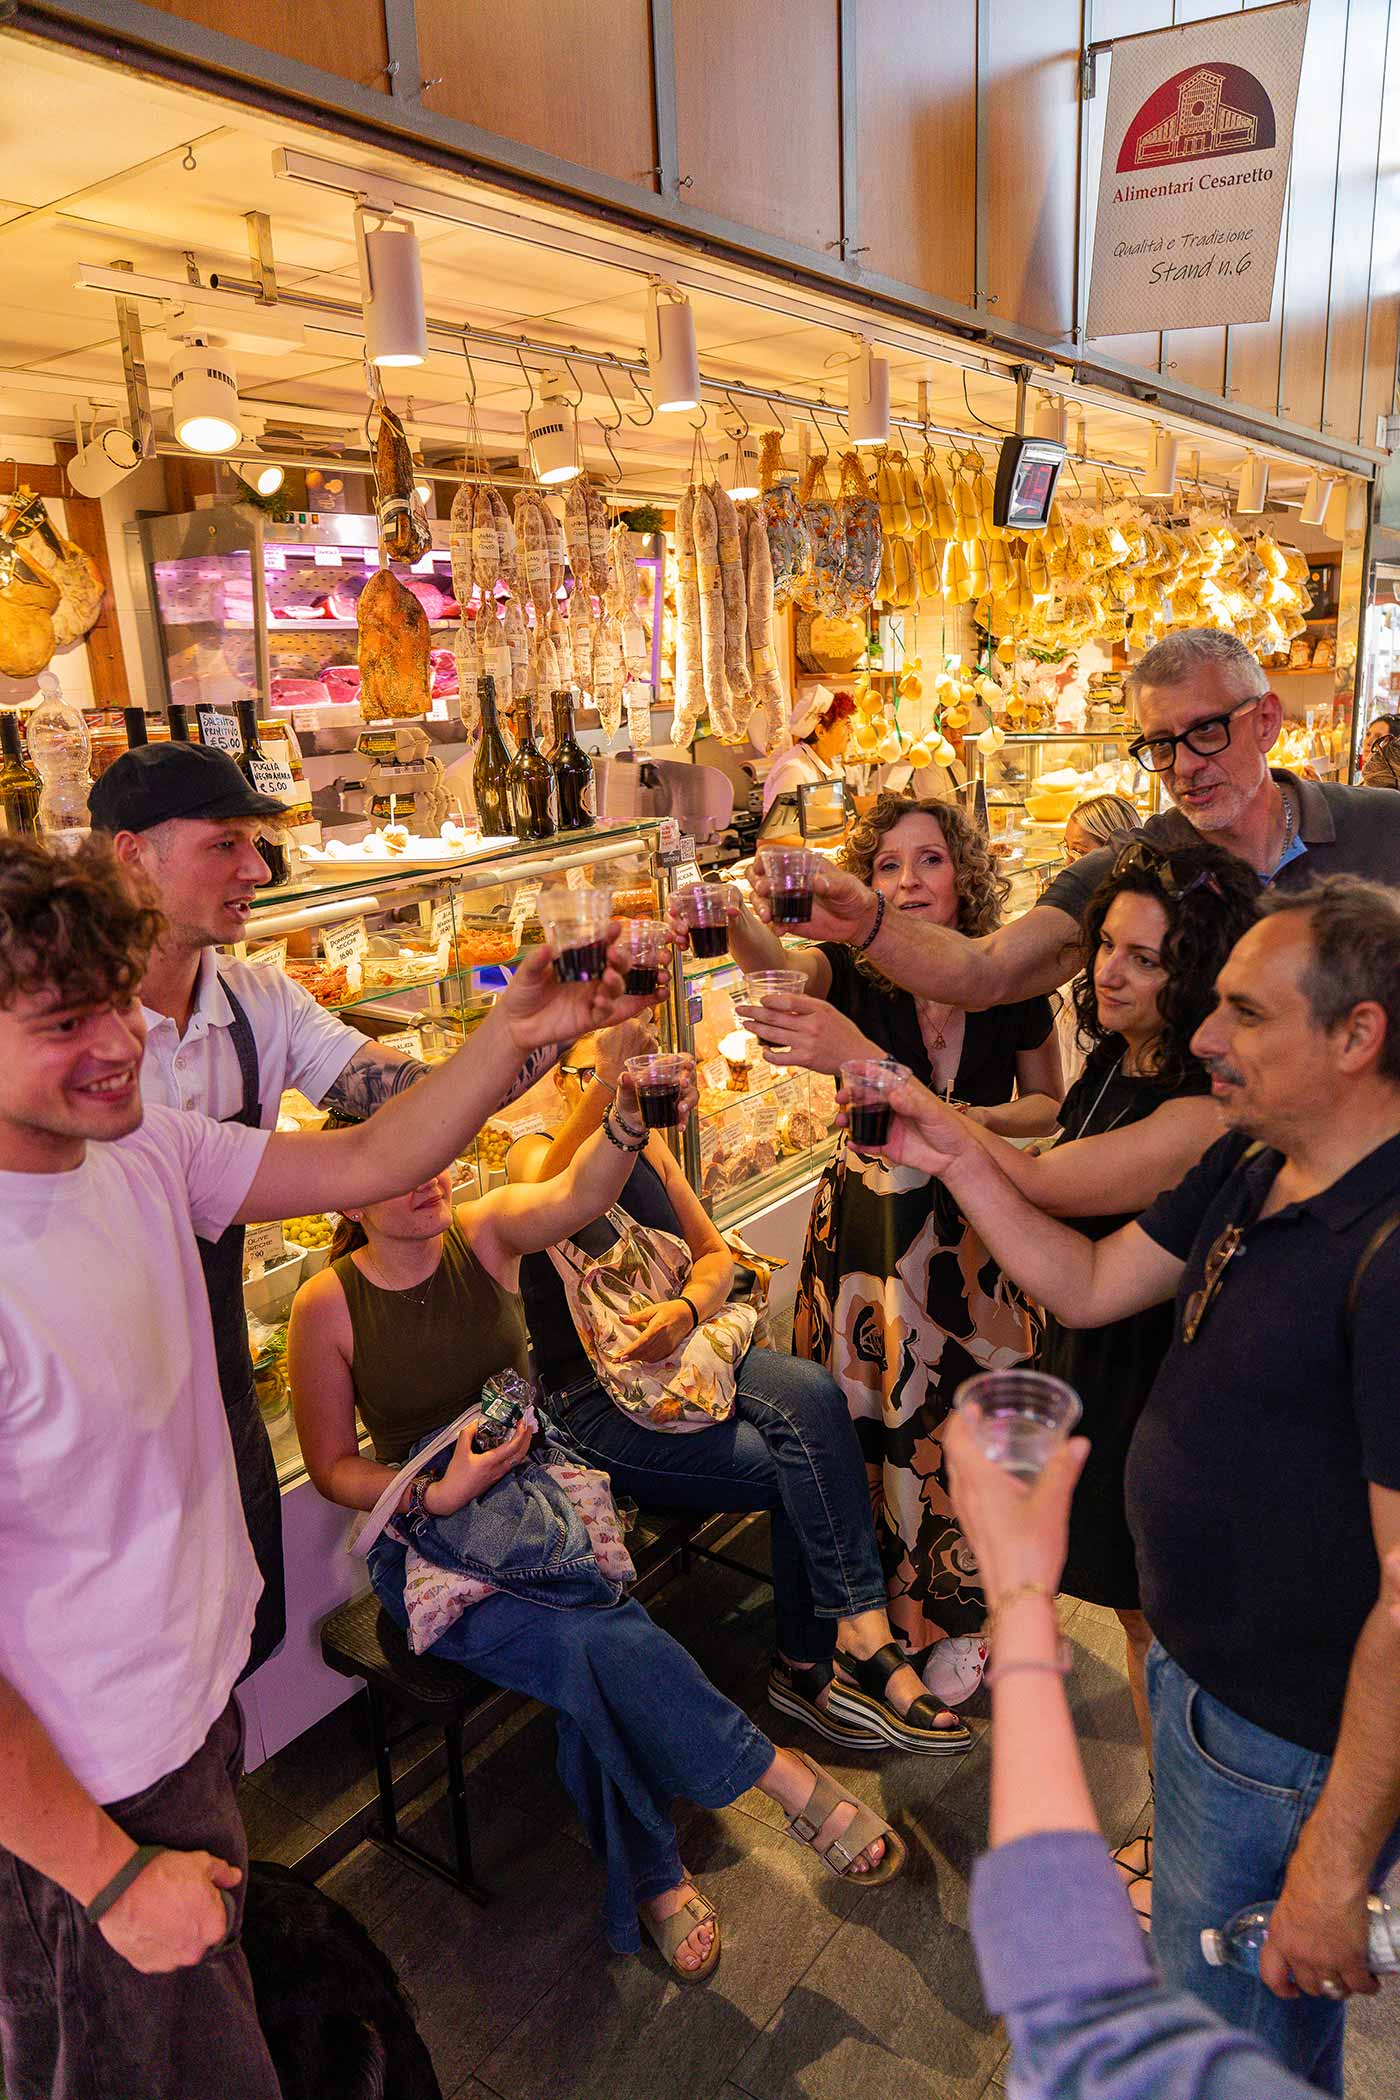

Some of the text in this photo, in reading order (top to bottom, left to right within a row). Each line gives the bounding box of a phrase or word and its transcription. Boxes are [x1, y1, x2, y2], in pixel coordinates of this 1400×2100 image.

[1112, 167, 1273, 204] Alimentari Cesaretto
[1113, 228, 1254, 258] Qualità e Tradizione
[1148, 252, 1252, 285] Stand n.6
[204, 727, 239, 737] PRIMITIVO
[252, 762, 280, 772] PUGLIA
[247, 1234, 269, 1246] OLIVE
